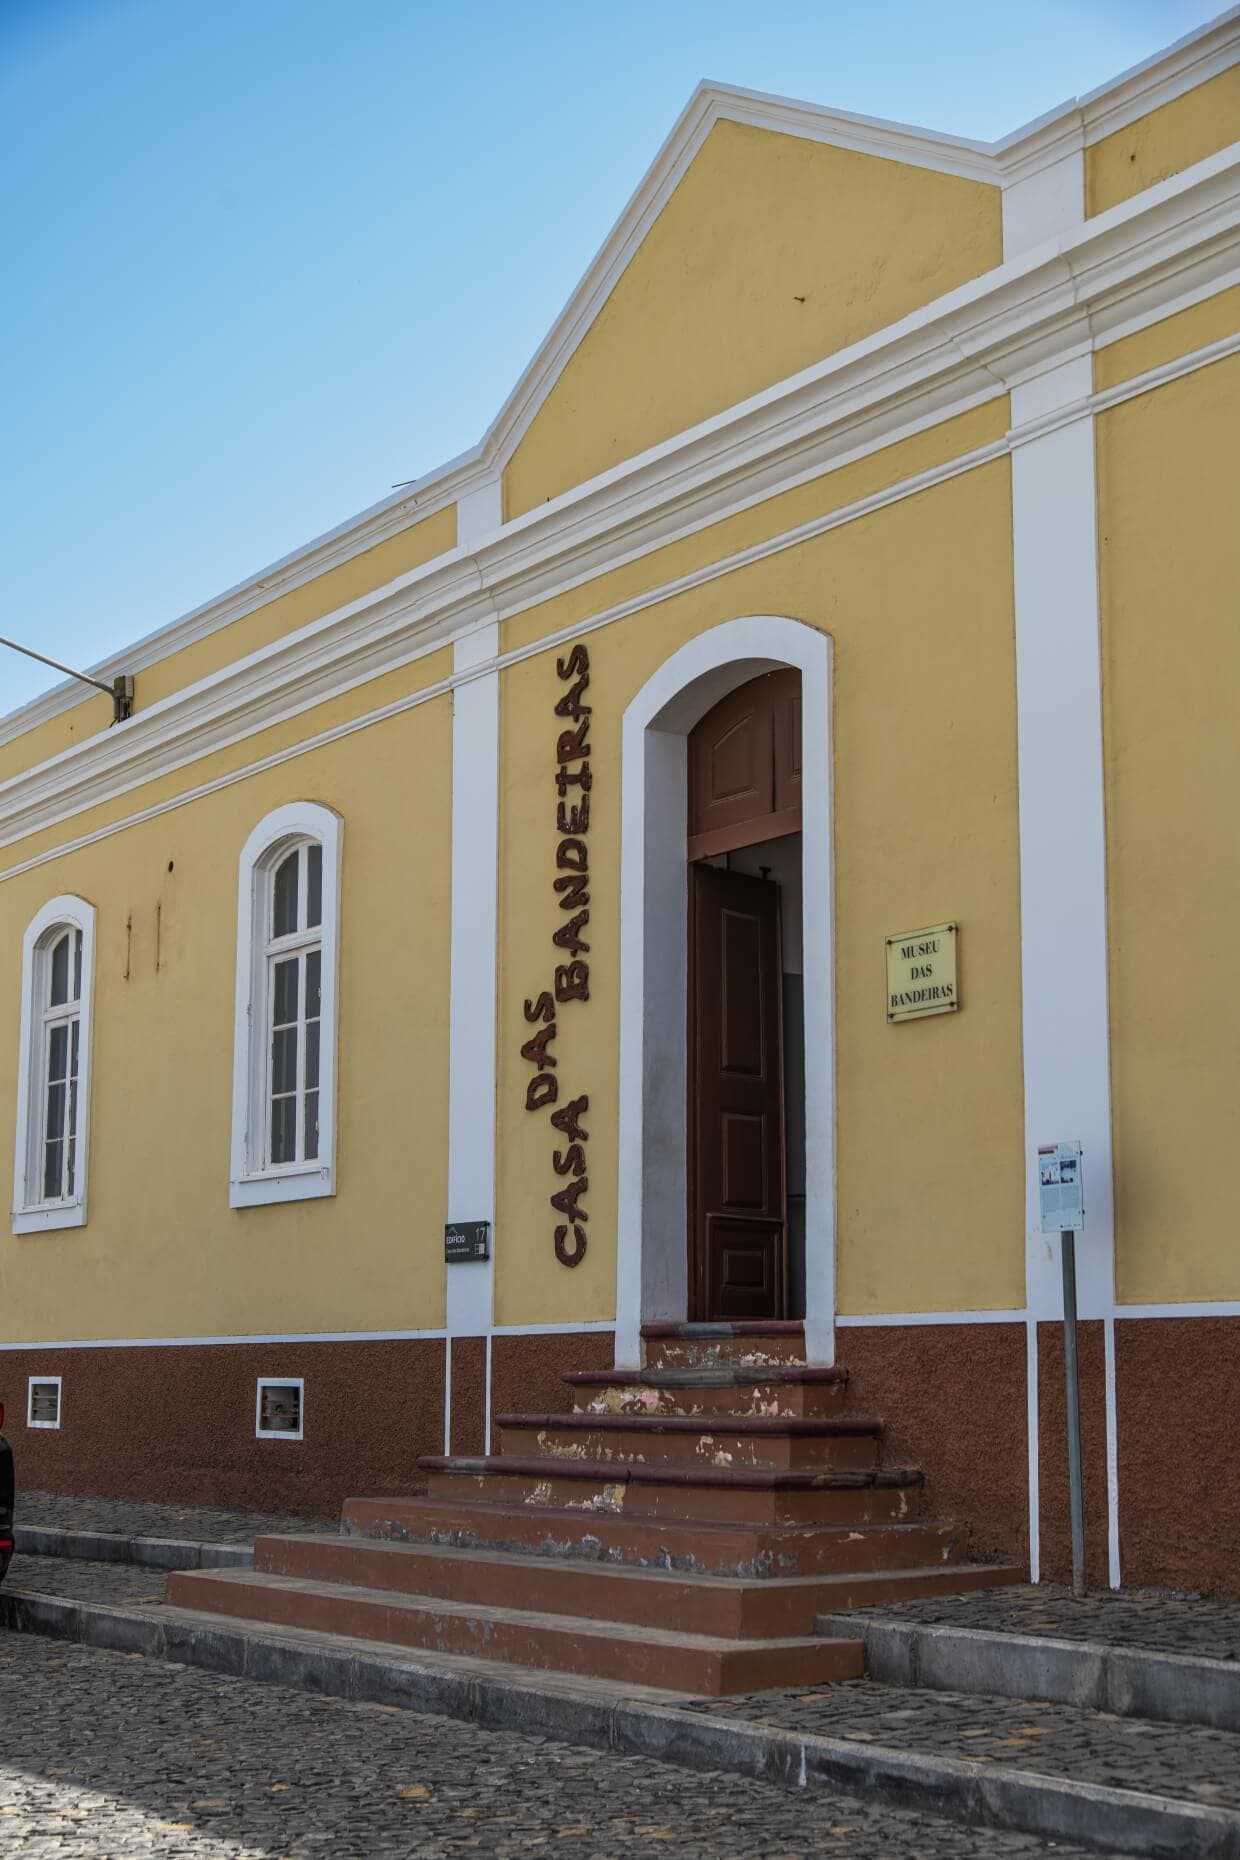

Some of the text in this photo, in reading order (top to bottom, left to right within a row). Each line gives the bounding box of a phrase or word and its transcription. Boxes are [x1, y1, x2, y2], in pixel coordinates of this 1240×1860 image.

[520, 644, 593, 1268] CASA DAS BANDEIRAS
[901, 940, 938, 960] MUSEU
[911, 963, 933, 981] DAS
[890, 983, 953, 1008] BANDEIRAS
